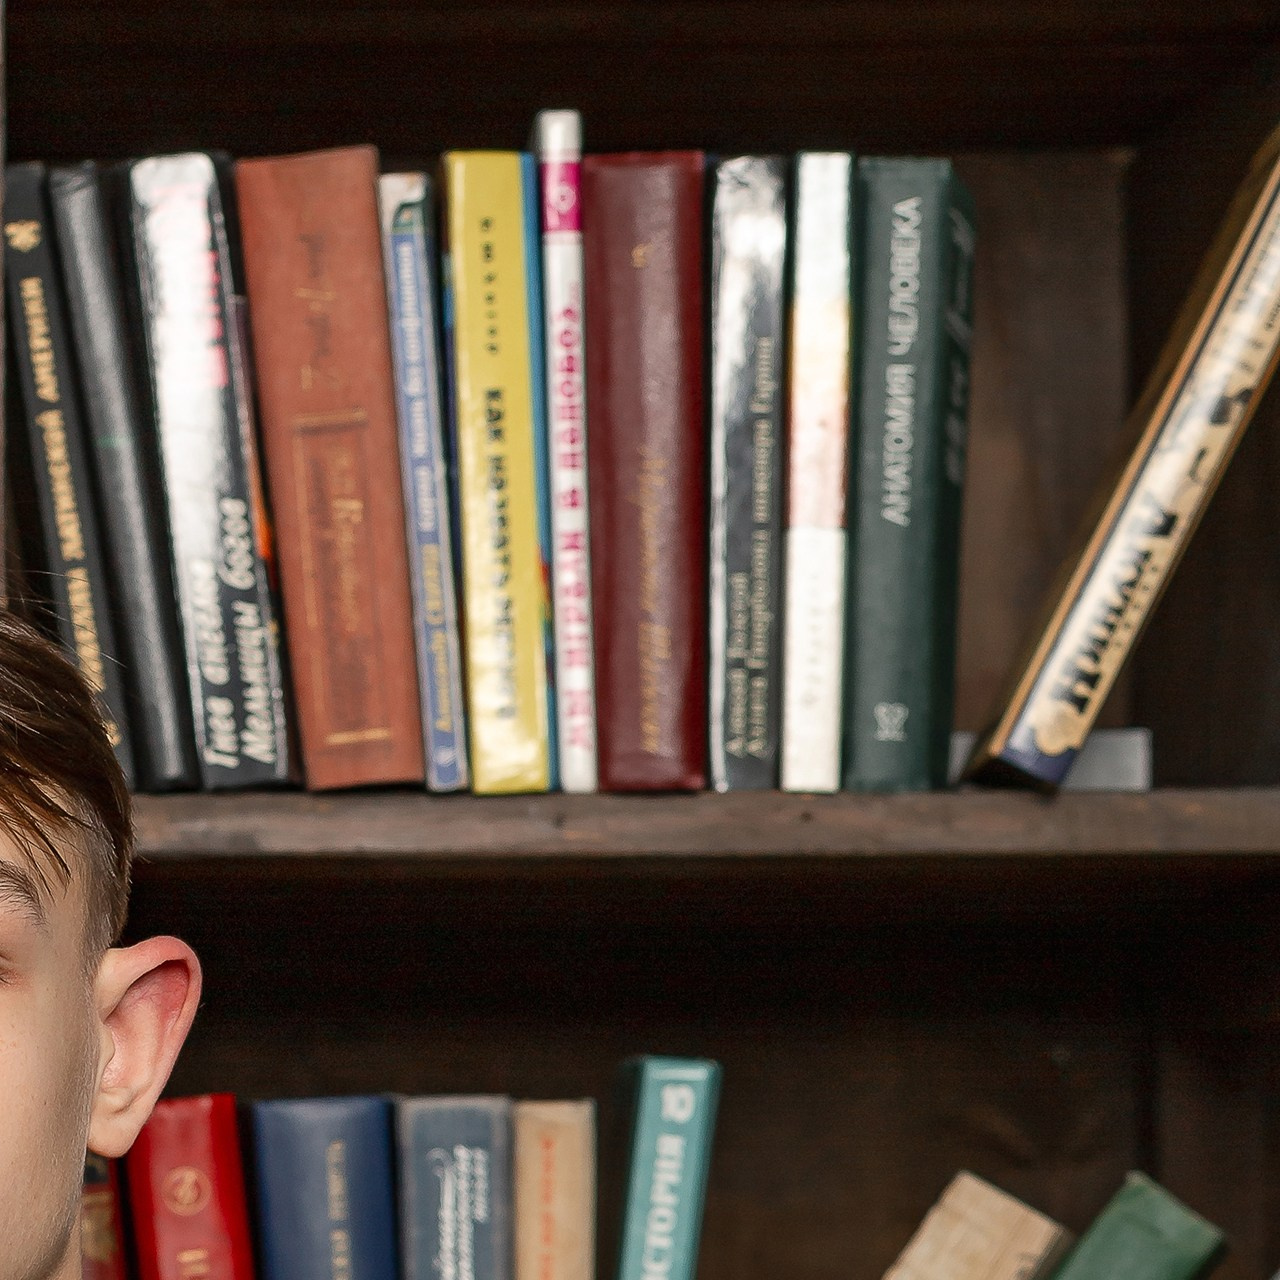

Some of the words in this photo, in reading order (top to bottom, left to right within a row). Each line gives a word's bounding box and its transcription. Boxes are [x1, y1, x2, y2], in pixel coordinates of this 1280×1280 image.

[17, 274, 62, 405] АМЕРИКИ
[884, 195, 923, 357] ЧЕЛОВЕКА
[33, 407, 85, 561] ЛАТИНСКОЙ
[879, 363, 917, 527] АНАТОМИЯ
[198, 693, 240, 770] Гнев
[230, 597, 277, 766] Мельницы
